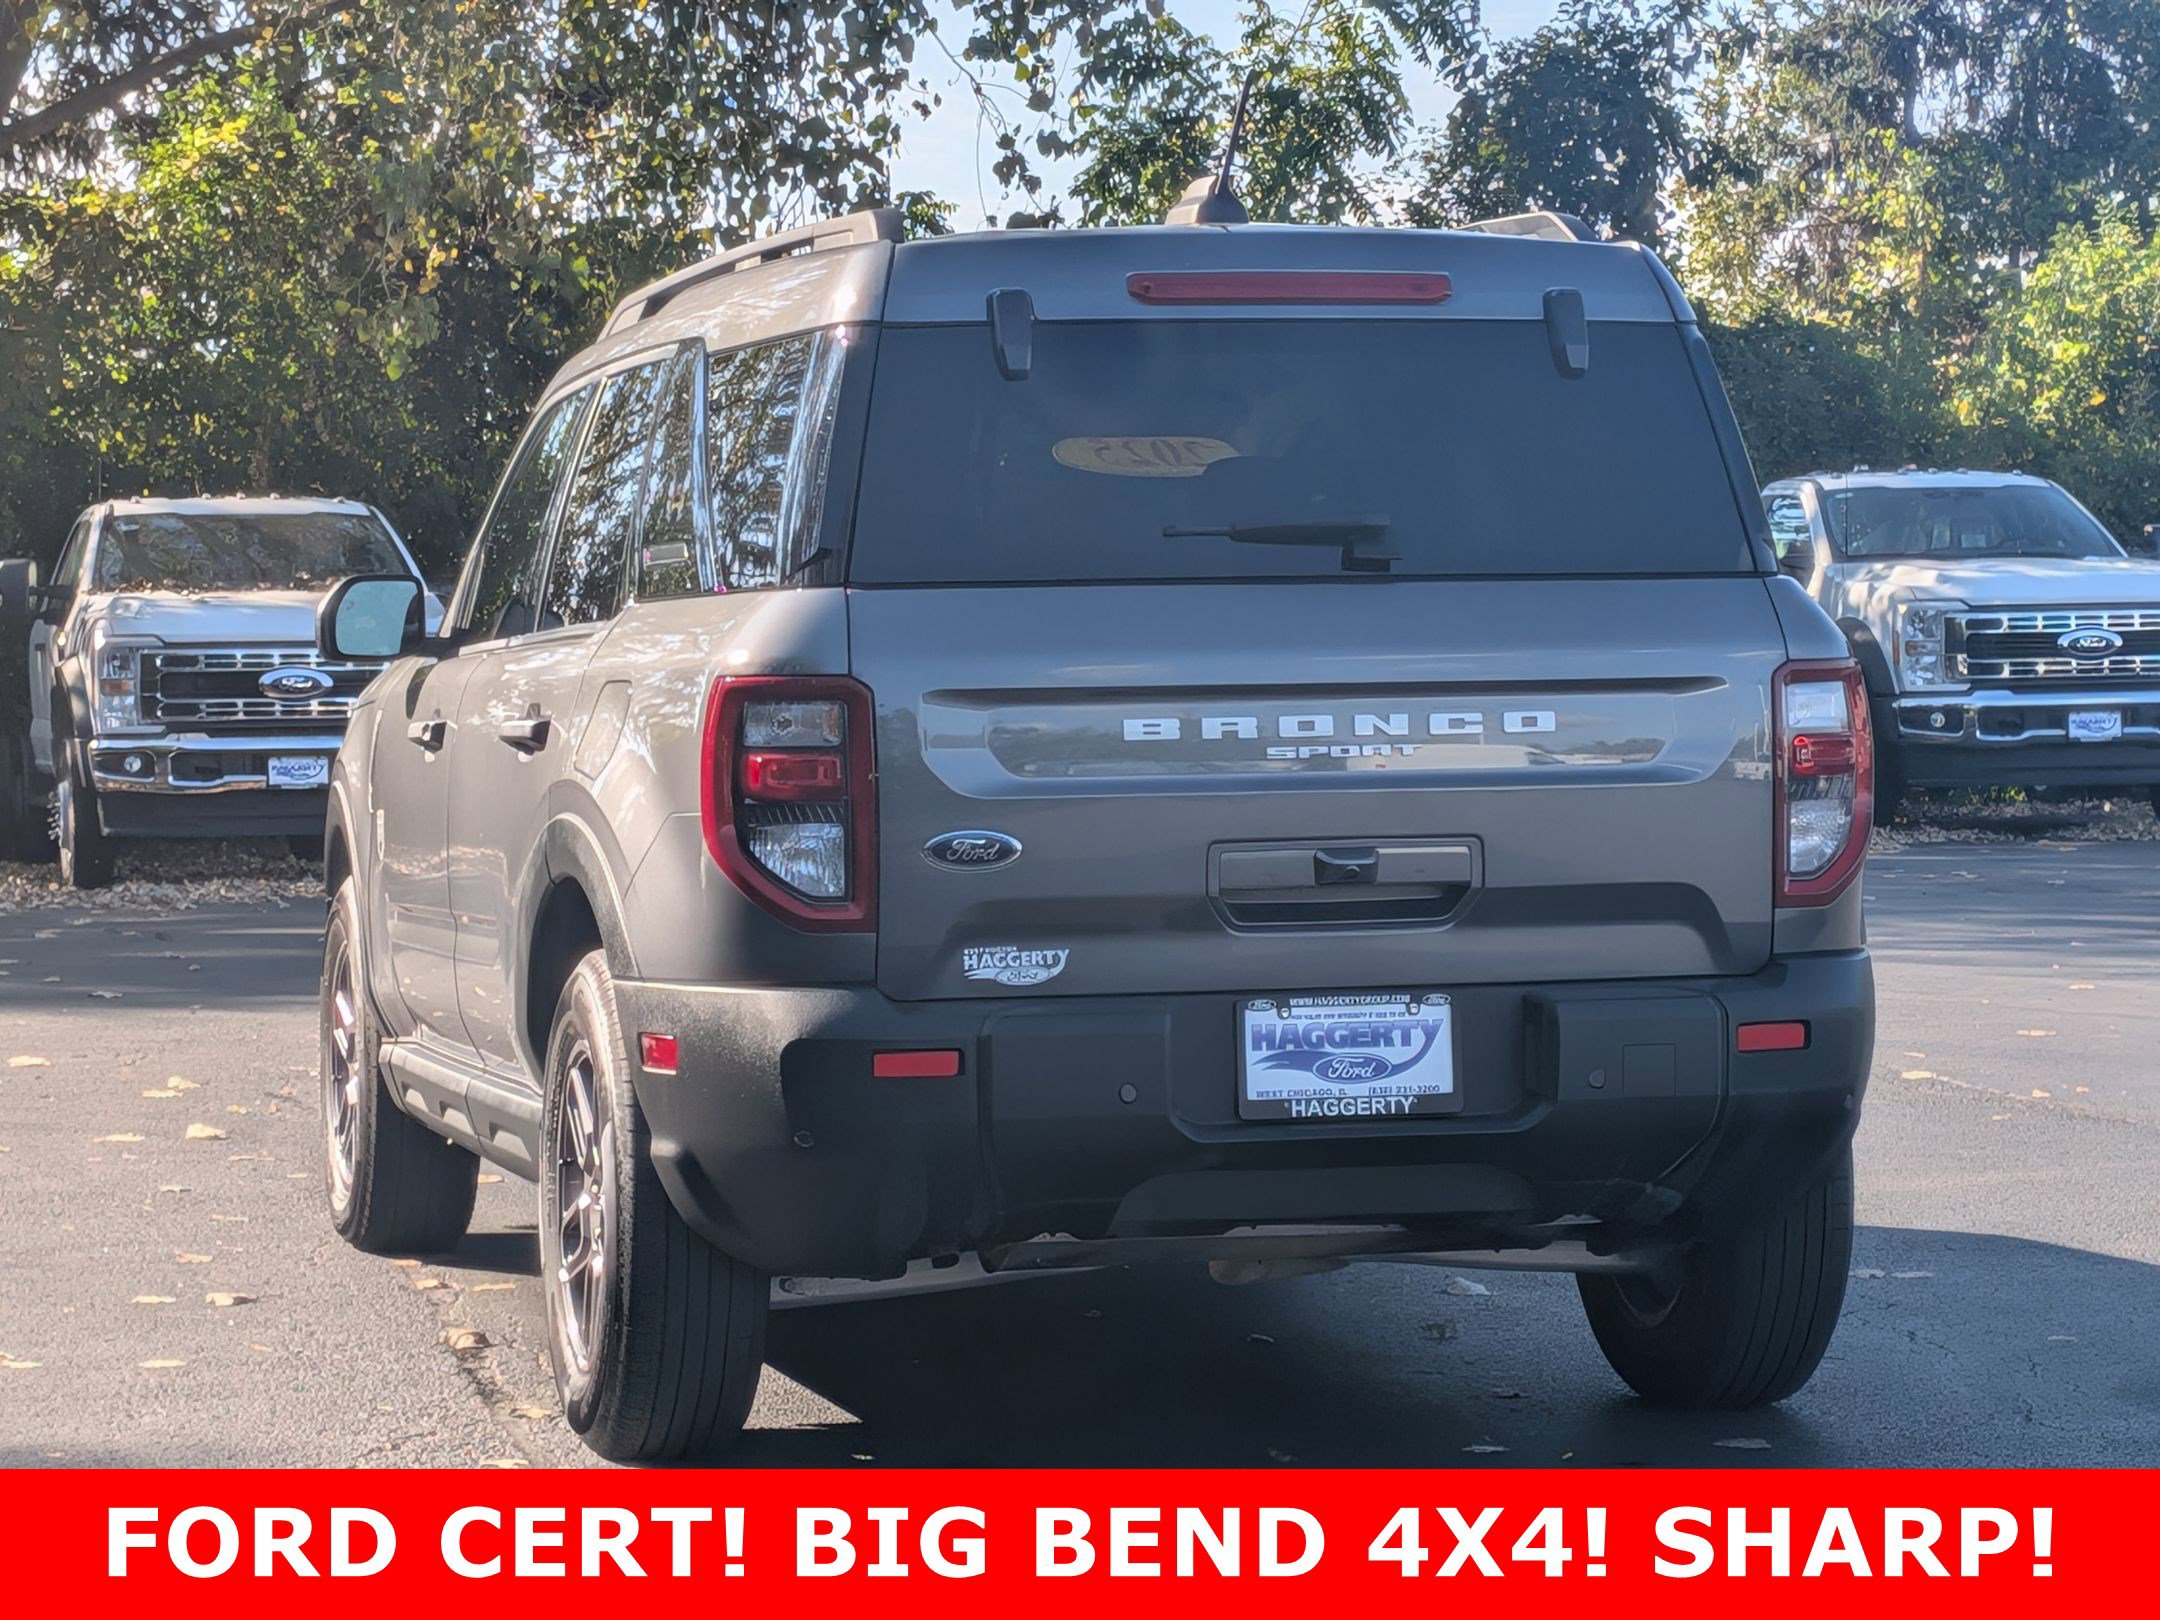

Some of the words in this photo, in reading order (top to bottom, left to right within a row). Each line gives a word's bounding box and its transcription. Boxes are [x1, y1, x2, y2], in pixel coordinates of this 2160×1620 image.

[1121, 710, 1557, 742] BRONCO
[1265, 743, 1423, 760] SPORT
[946, 838, 1000, 861] Ford
[963, 948, 1070, 971] HAGGERTY
[1250, 1018, 1444, 1052] HAGGERTY
[1327, 1057, 1376, 1080] Ford
[1255, 1090, 1284, 1099] WEST
[1290, 1096, 1415, 1118] HAGGERTY
